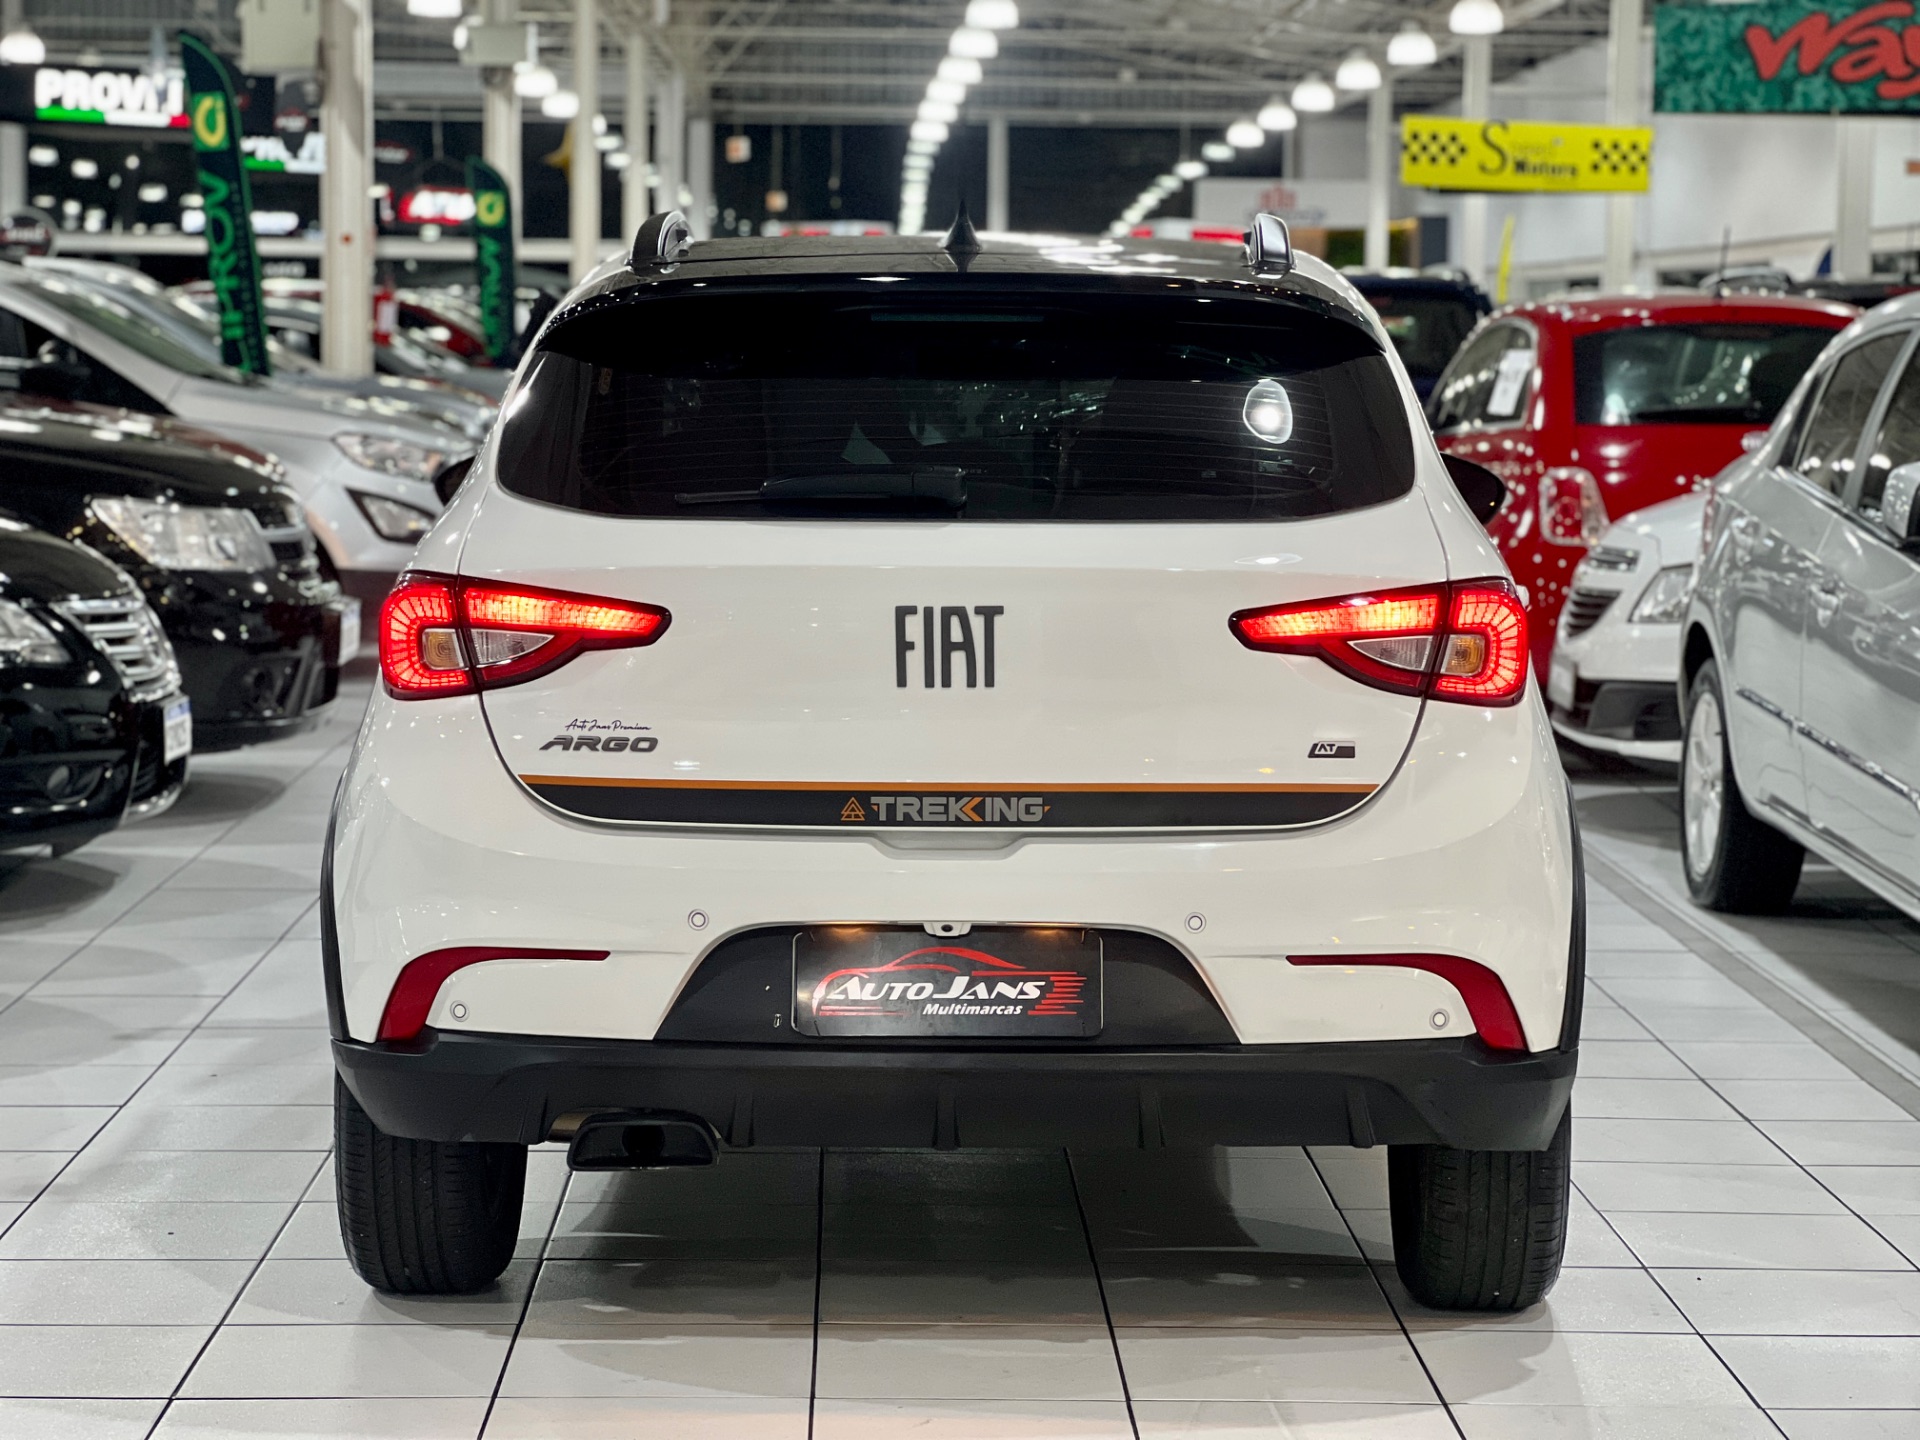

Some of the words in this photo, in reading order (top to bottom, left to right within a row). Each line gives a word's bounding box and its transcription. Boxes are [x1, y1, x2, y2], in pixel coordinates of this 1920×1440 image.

[895, 605, 1004, 688] FIAT
[539, 734, 659, 752] ARGO
[870, 796, 1045, 822] TREKKING
[922, 1003, 1023, 1015] Multimarcas
